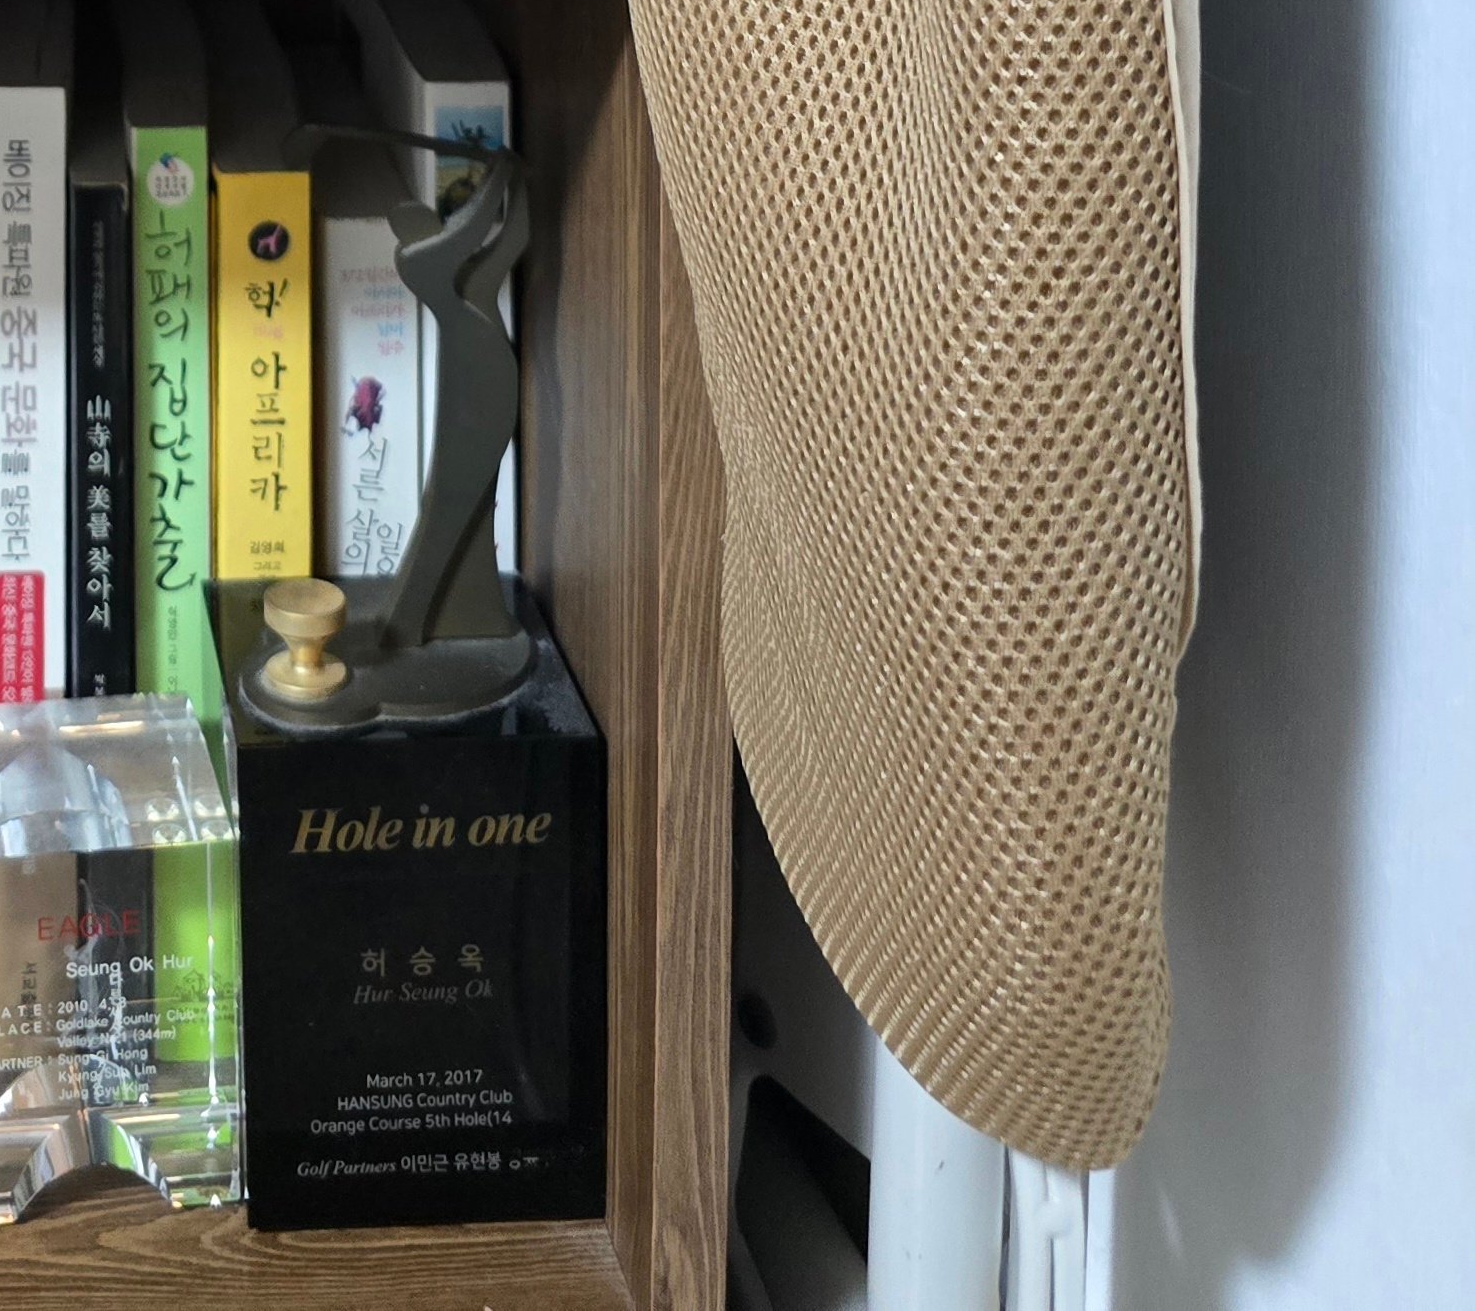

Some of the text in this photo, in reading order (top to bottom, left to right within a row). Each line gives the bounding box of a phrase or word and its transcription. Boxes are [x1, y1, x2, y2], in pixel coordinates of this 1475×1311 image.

[2, 138, 33, 212] 베이징
[0, 306, 37, 373] 중국
[0, 382, 37, 475] 문화를
[249, 351, 288, 513] 아프리카
[0, 484, 32, 563] 말하다
[289, 803, 553, 855] Hole in one
[37, 909, 142, 943] EAGLE
[66, 954, 194, 980] Seung Ok Hur
[399, 983, 457, 1004] Seung
[56, 1007, 195, 1030] Goldlake Club
[366, 1068, 484, 1088] March 2017
[337, 1089, 514, 1112] HANSUNG Country Club
[311, 1112, 451, 1136] Orange Course 5th
[297, 1159, 332, 1178] Golf
[333, 1159, 397, 1175] Partners
[400, 1154, 449, 1173] 이민근
[453, 1152, 502, 1171] 유현봉
